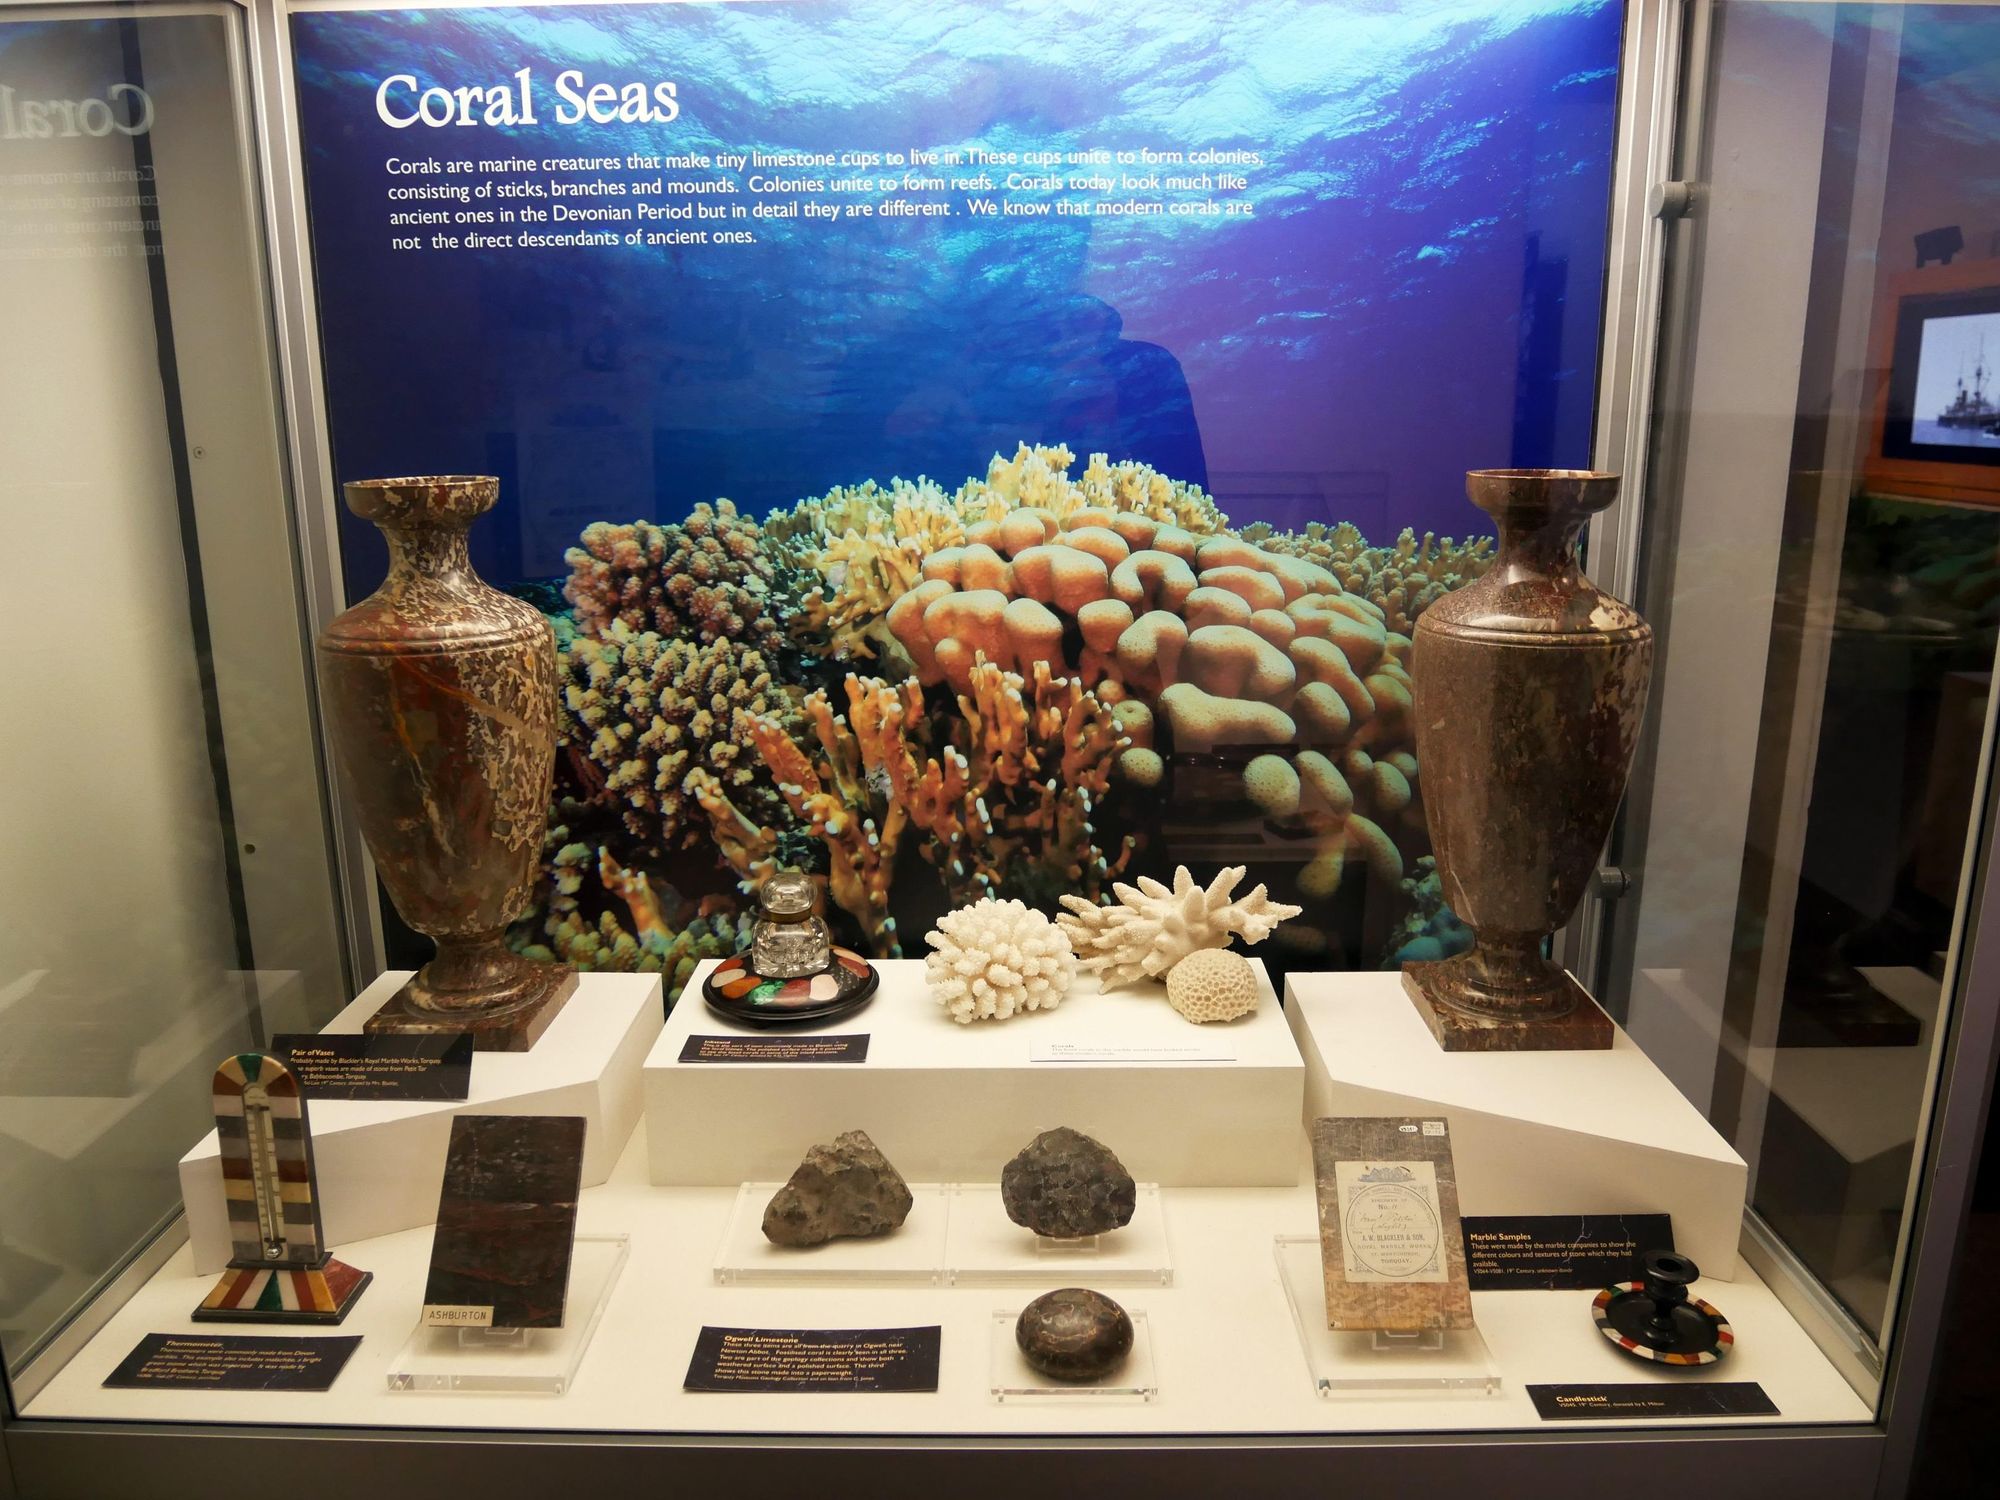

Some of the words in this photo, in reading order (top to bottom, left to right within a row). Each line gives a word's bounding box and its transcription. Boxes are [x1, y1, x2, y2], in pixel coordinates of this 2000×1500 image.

[376, 67, 537, 128] Coral
[555, 70, 679, 124] Seas
[386, 157, 441, 174] Corals
[447, 161, 473, 173] are
[479, 157, 536, 172] marine
[542, 156, 621, 171] creatures
[627, 153, 660, 169] that
[666, 152, 710, 168] make
[716, 153, 747, 171] tiny
[752, 151, 835, 167] limestone
[841, 153, 879, 170] cups
[886, 152, 904, 165] to
[911, 149, 938, 165] live
[944, 149, 964, 164] in.
[967, 148, 1017, 164] These
[1023, 151, 1061, 168] cups
[1068, 148, 1111, 164] unite
[1117, 151, 1135, 164] to
[1141, 148, 1182, 164] form
[1188, 148, 1263, 165] colonies,
[388, 184, 470, 202] consisting
[475, 181, 492, 197] of
[497, 181, 547, 198] sticks,
[551, 179, 626, 196] branches
[632, 178, 661, 195] and
[668, 177, 739, 193] mounds.
[749, 176, 824, 192] Colonies
[831, 176, 873, 191] unite
[879, 178, 897, 191] to
[903, 174, 944, 190] form
[951, 174, 996, 190] reefs.
[1007, 173, 1063, 190] Corals
[1069, 174, 1116, 193] today
[1122, 173, 1159, 190] look
[1166, 173, 1211, 190] much
[1218, 173, 1247, 190] like
[390, 209, 450, 224] ancient
[455, 211, 494, 223] ones
[500, 208, 514, 222] in
[520, 206, 547, 222] the
[553, 205, 631, 221] Devonian
[638, 203, 692, 220] Period
[698, 203, 726, 219] but
[732, 203, 746, 218] in
[753, 201, 797, 218] detail
[804, 201, 840, 221] they
[846, 204, 872, 217] are
[967, 199, 997, 215] We
[1003, 199, 1050, 215] know
[1056, 200, 1090, 215] that
[1097, 199, 1163, 215] modern
[1169, 199, 1219, 214] corals
[1226, 202, 1253, 214] are
[392, 237, 421, 250] not
[432, 233, 458, 249] the
[465, 232, 512, 248] direct
[518, 230, 619, 247] descendants
[625, 229, 642, 245] of
[647, 229, 707, 244] ancient
[713, 231, 757, 243] ones.
[330, 1058, 338, 1066] by
[365, 1058, 380, 1066] Royal
[1470, 1233, 1497, 1241] Marble
[1498, 1233, 1531, 1242] Samples
[1606, 1250, 1619, 1258] they
[429, 1311, 486, 1320] ASHBURTON
